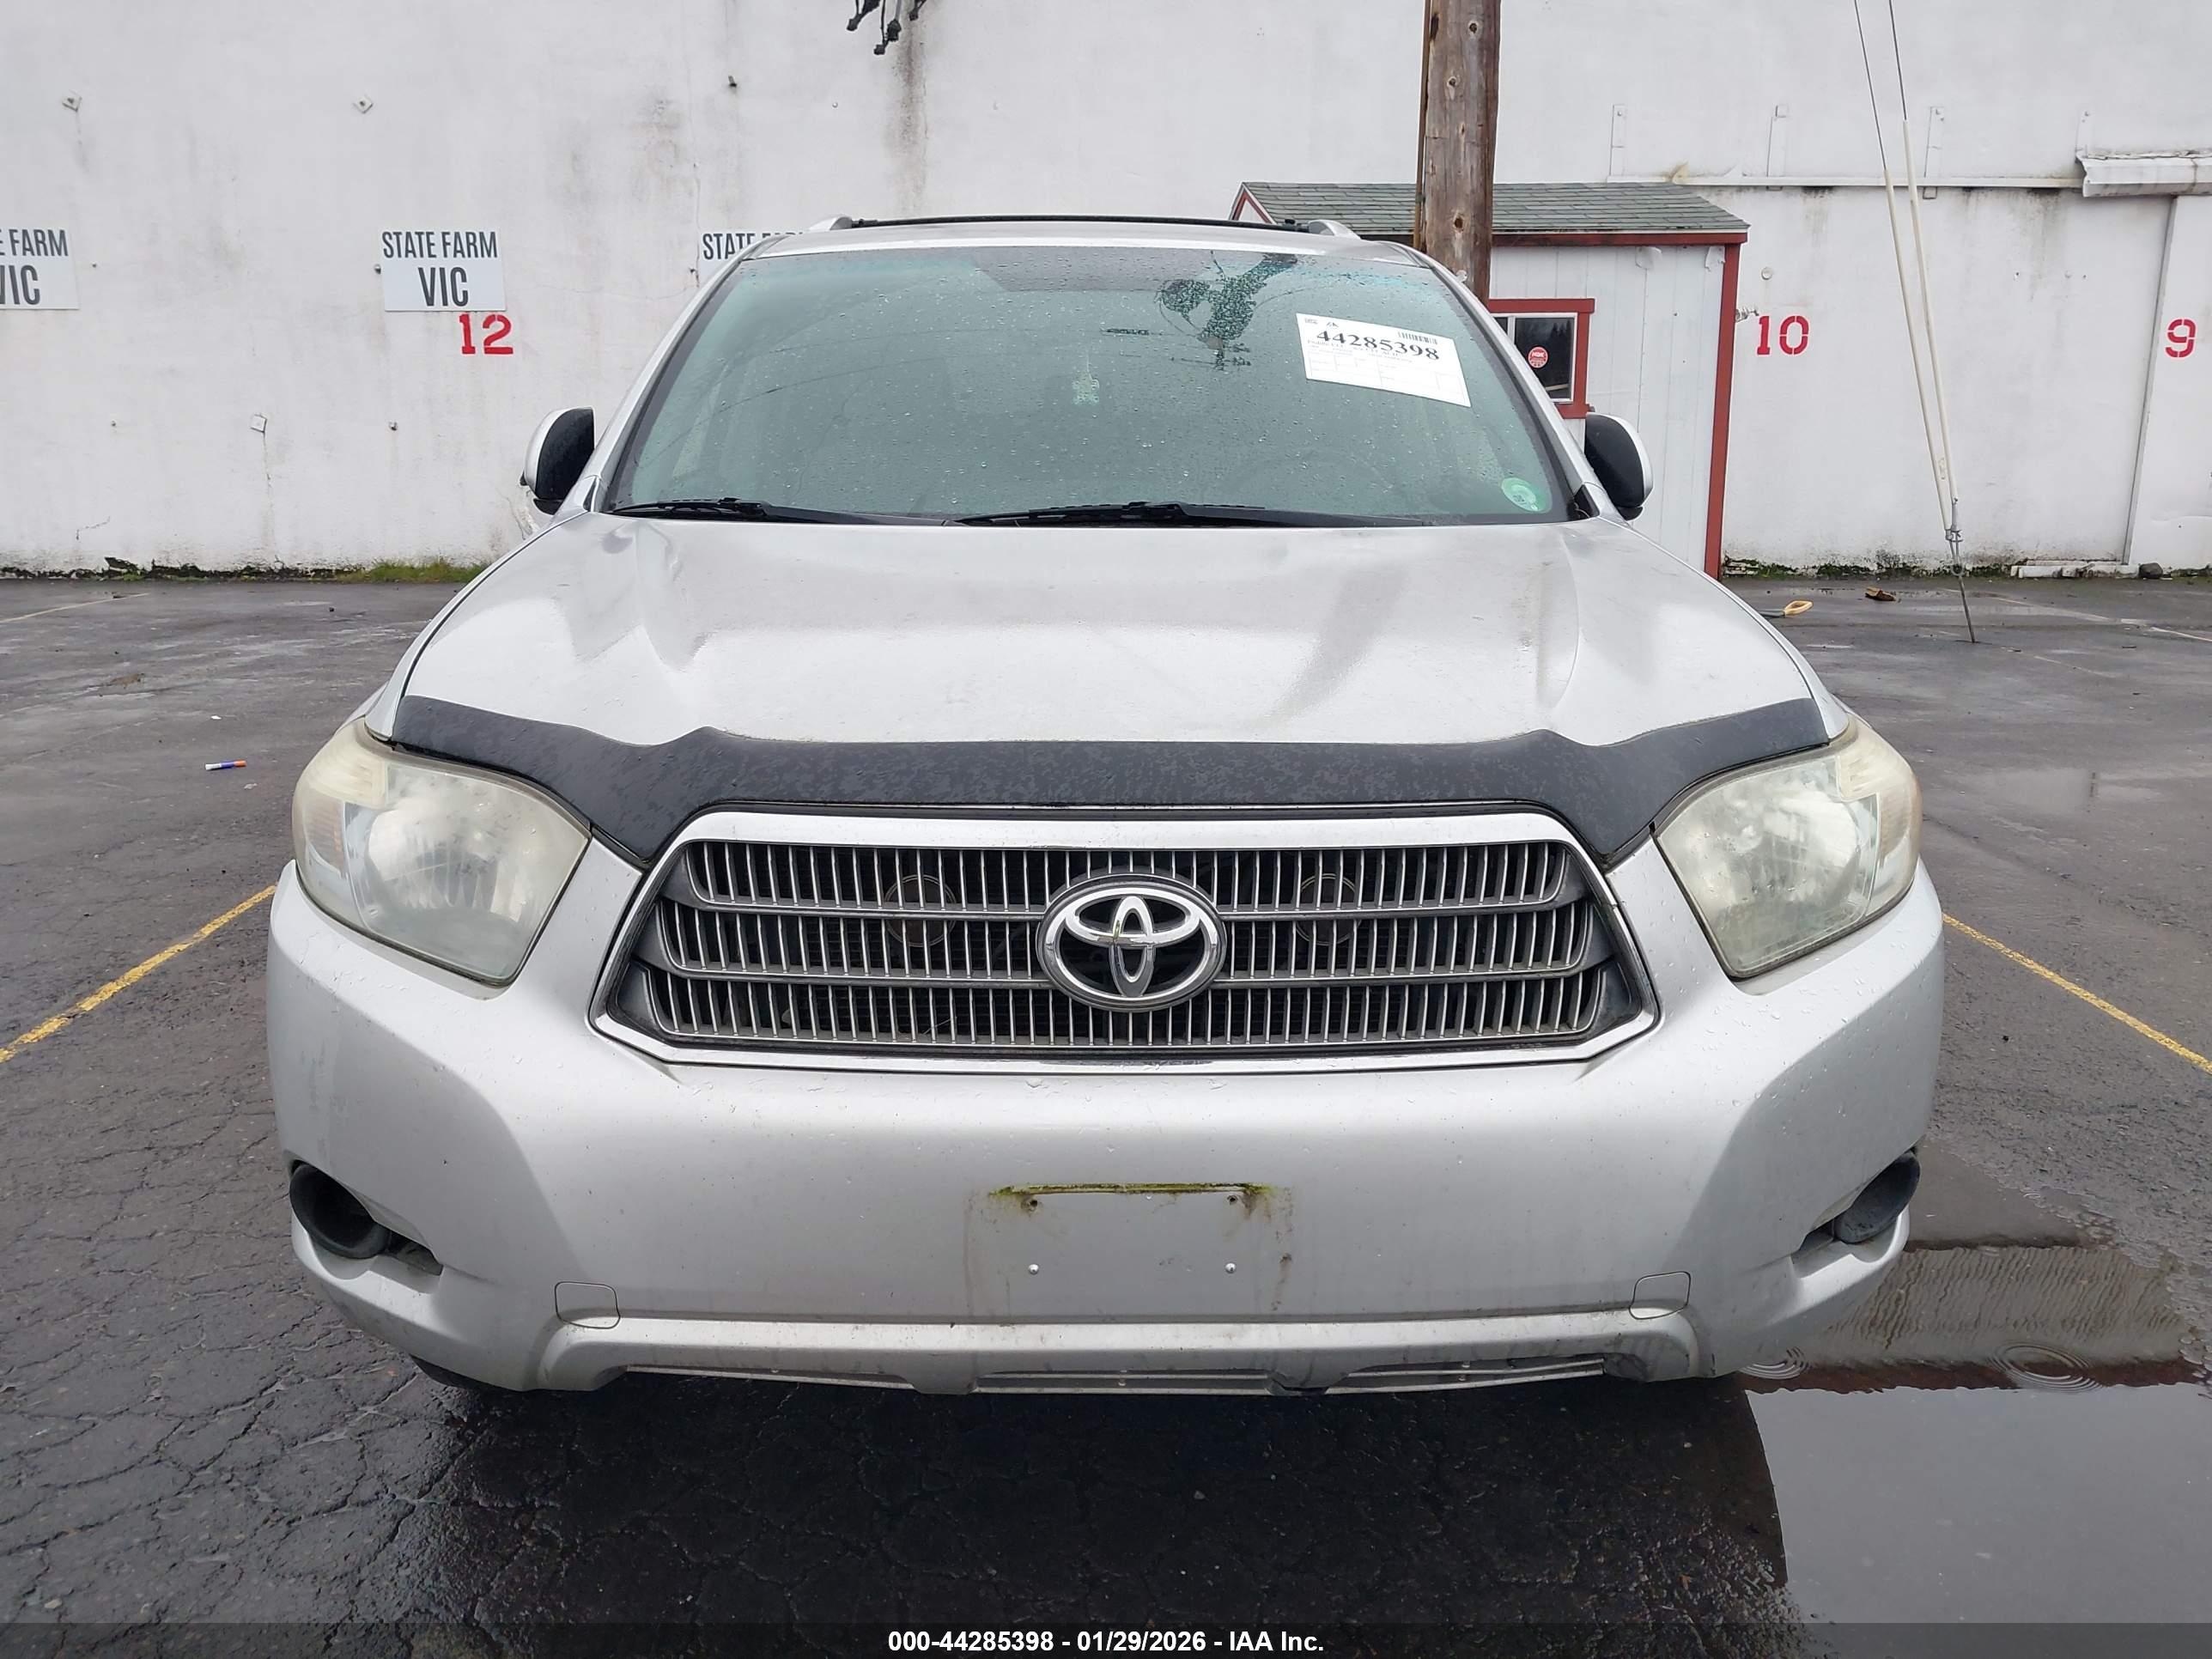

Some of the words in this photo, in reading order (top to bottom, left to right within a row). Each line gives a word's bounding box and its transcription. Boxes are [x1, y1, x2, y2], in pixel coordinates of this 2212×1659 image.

[8, 228, 69, 257] FARM
[381, 231, 437, 258] STATE
[441, 231, 498, 258] FARM
[417, 266, 469, 307] VIC
[459, 313, 514, 355] 12
[1316, 330, 1440, 361] 44285398
[1757, 315, 1809, 356] 10
[2166, 319, 2197, 358] 9
